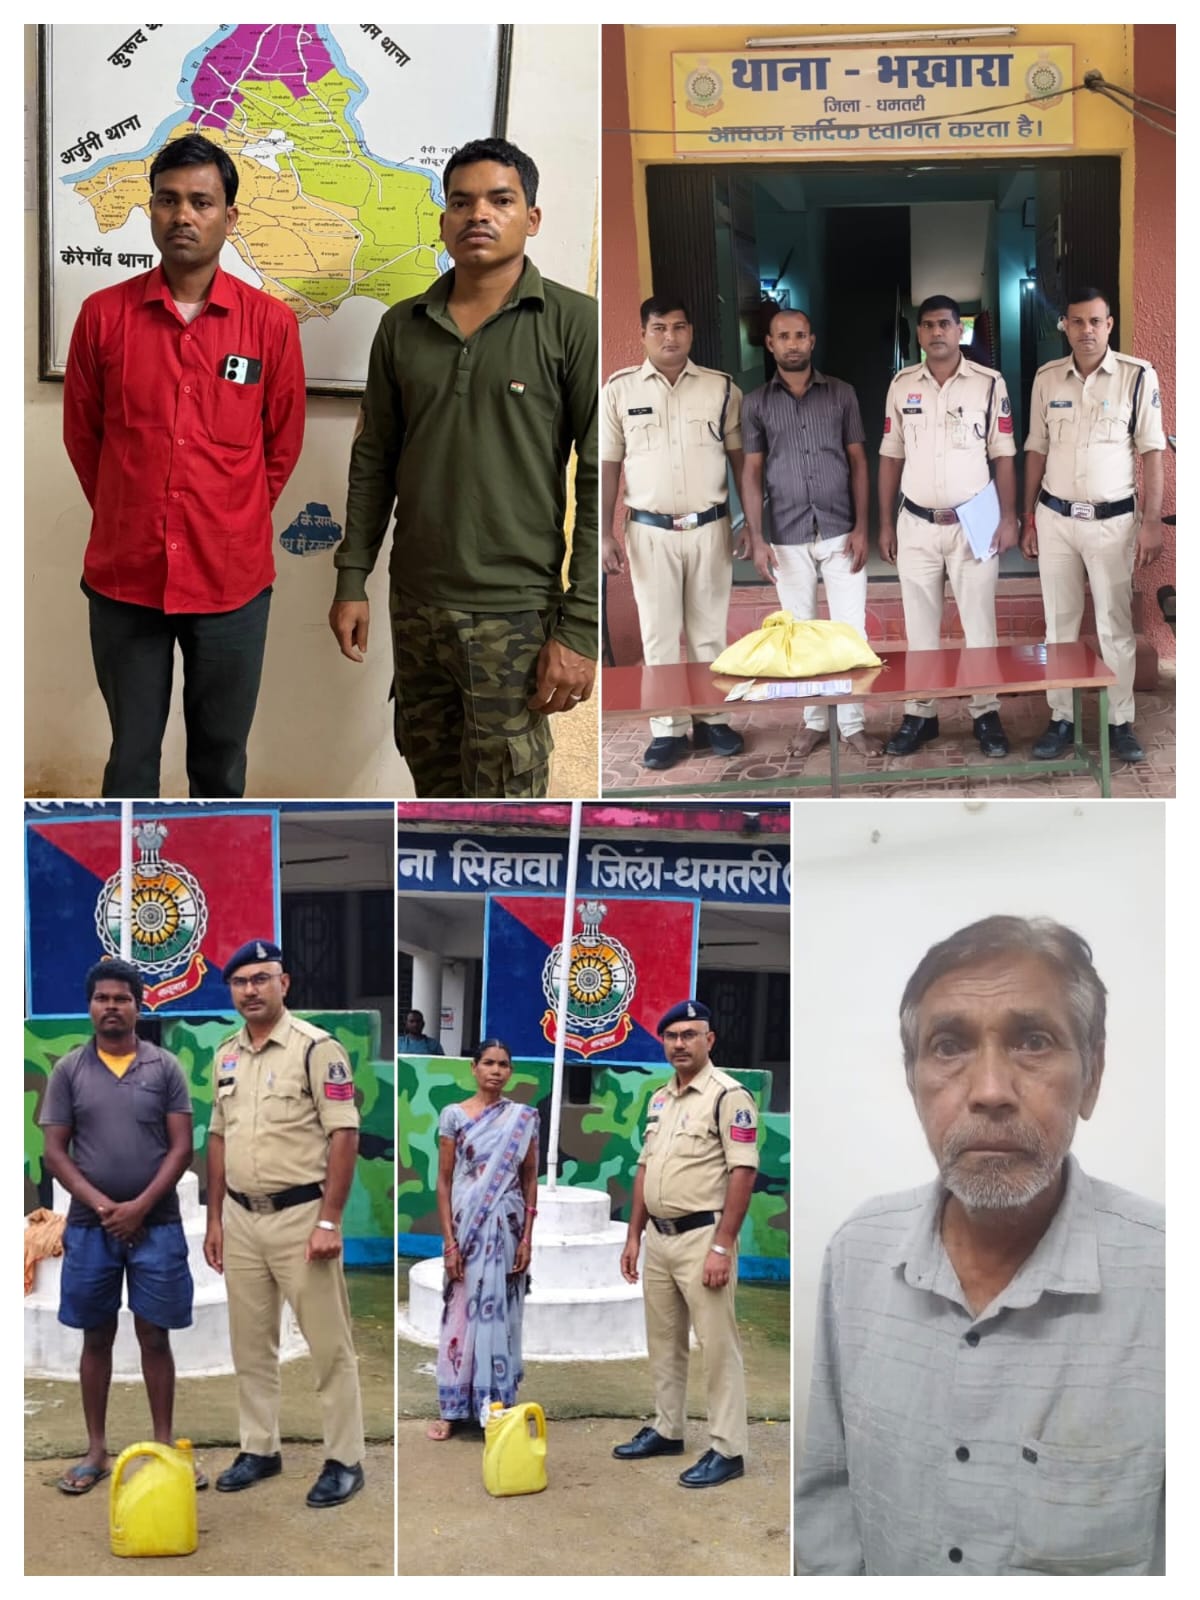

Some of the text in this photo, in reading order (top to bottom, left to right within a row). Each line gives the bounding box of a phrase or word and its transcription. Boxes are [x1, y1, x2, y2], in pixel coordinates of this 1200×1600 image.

[107, 28, 148, 68] कुरूद
[381, 36, 411, 67] थाना
[732, 57, 831, 91] थाना
[877, 54, 1014, 89] भखारा
[823, 96, 861, 113] जिला
[877, 94, 926, 112] धमतरी
[59, 114, 142, 166] अर्जुनी थाना
[708, 125, 785, 143] आपका
[791, 118, 860, 142] हार्दिक
[868, 122, 942, 141] स्वागत
[948, 121, 1010, 138] करता
[60, 246, 153, 268] केरेगाँव थाना
[449, 839, 563, 888] सिहावा
